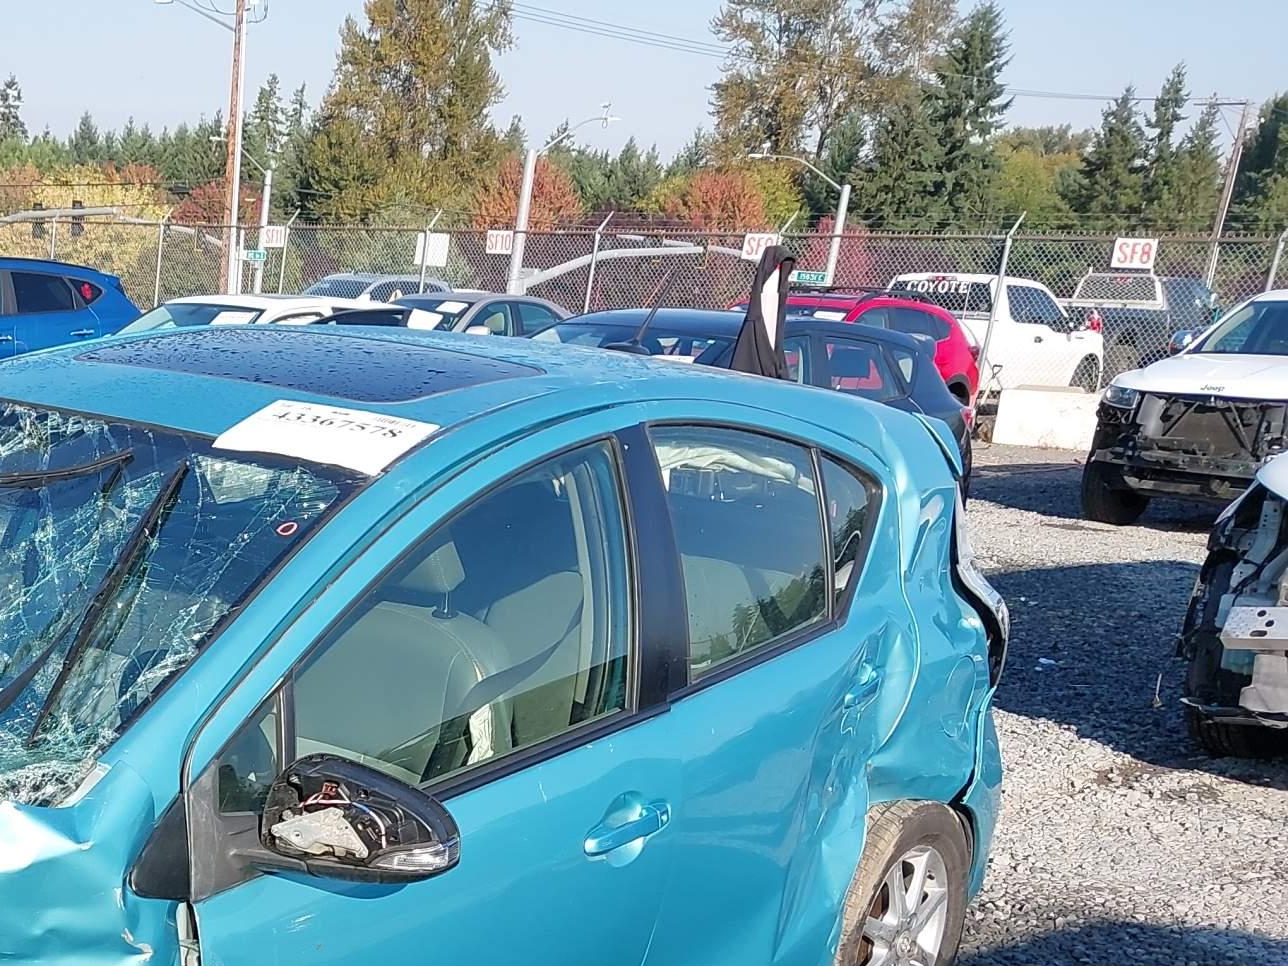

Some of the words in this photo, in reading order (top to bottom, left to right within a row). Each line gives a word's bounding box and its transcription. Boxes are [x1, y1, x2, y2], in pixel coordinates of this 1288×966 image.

[1117, 242, 1153, 264] SF8
[906, 280, 969, 293] COYOTE
[272, 411, 403, 439] 43367578
